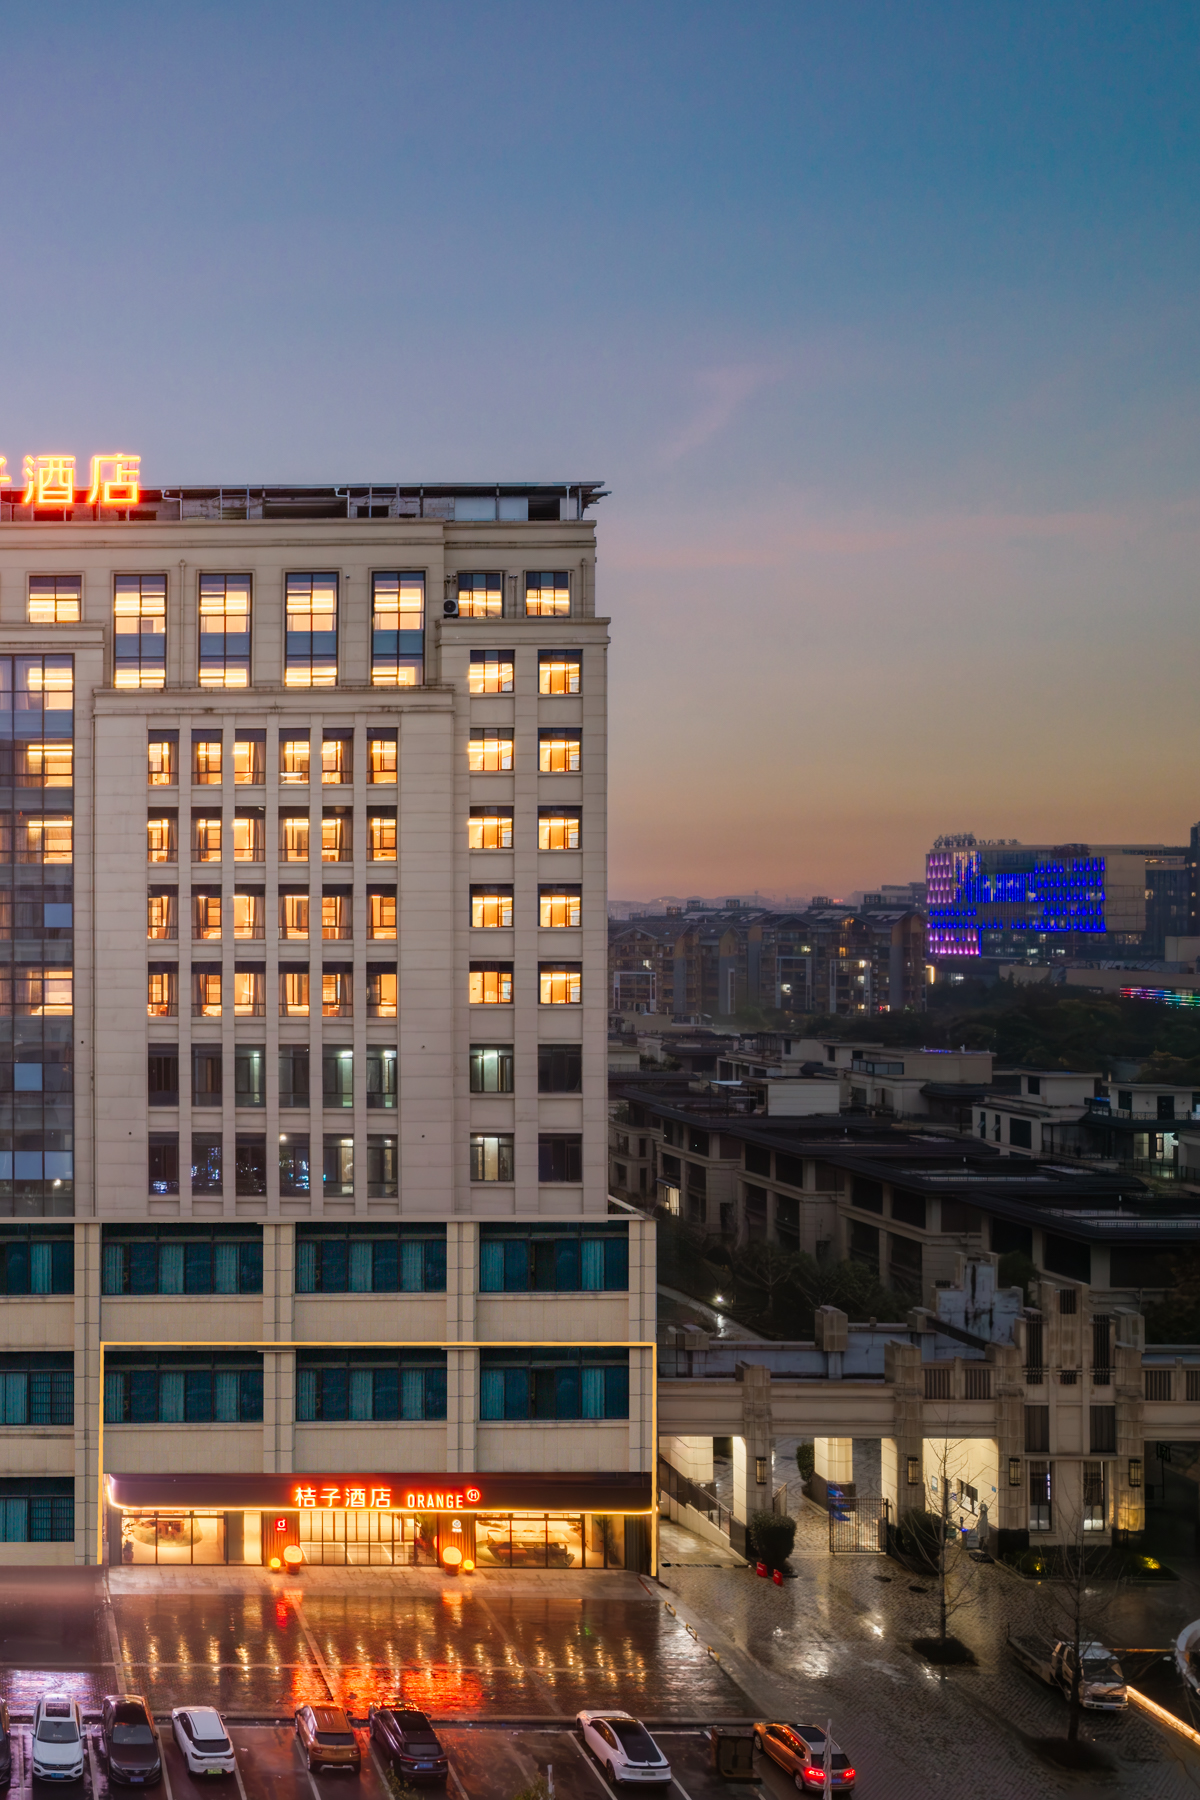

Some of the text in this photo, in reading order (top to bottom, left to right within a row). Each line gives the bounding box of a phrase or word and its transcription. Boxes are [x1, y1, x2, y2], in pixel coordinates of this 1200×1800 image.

[294, 1486, 392, 1509] 桔子酒店
[407, 1493, 464, 1509] ORANGE
